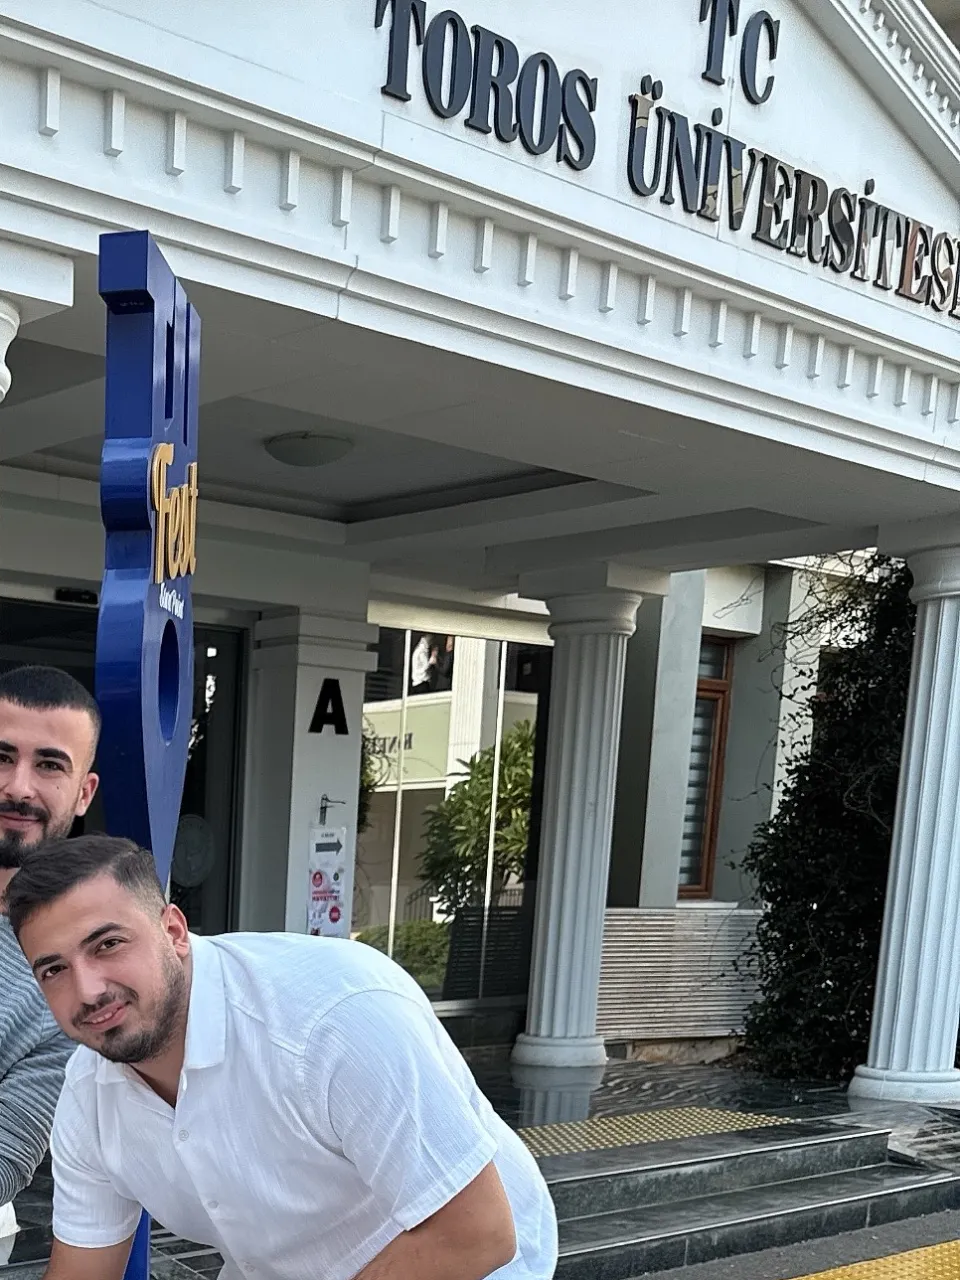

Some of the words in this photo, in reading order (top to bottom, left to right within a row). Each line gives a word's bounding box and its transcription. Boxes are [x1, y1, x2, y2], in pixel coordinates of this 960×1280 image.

[375, 0, 598, 171] TOROS
[699, 0, 781, 104] TC
[152, 442, 199, 584] Fest
[308, 678, 349, 735] A
